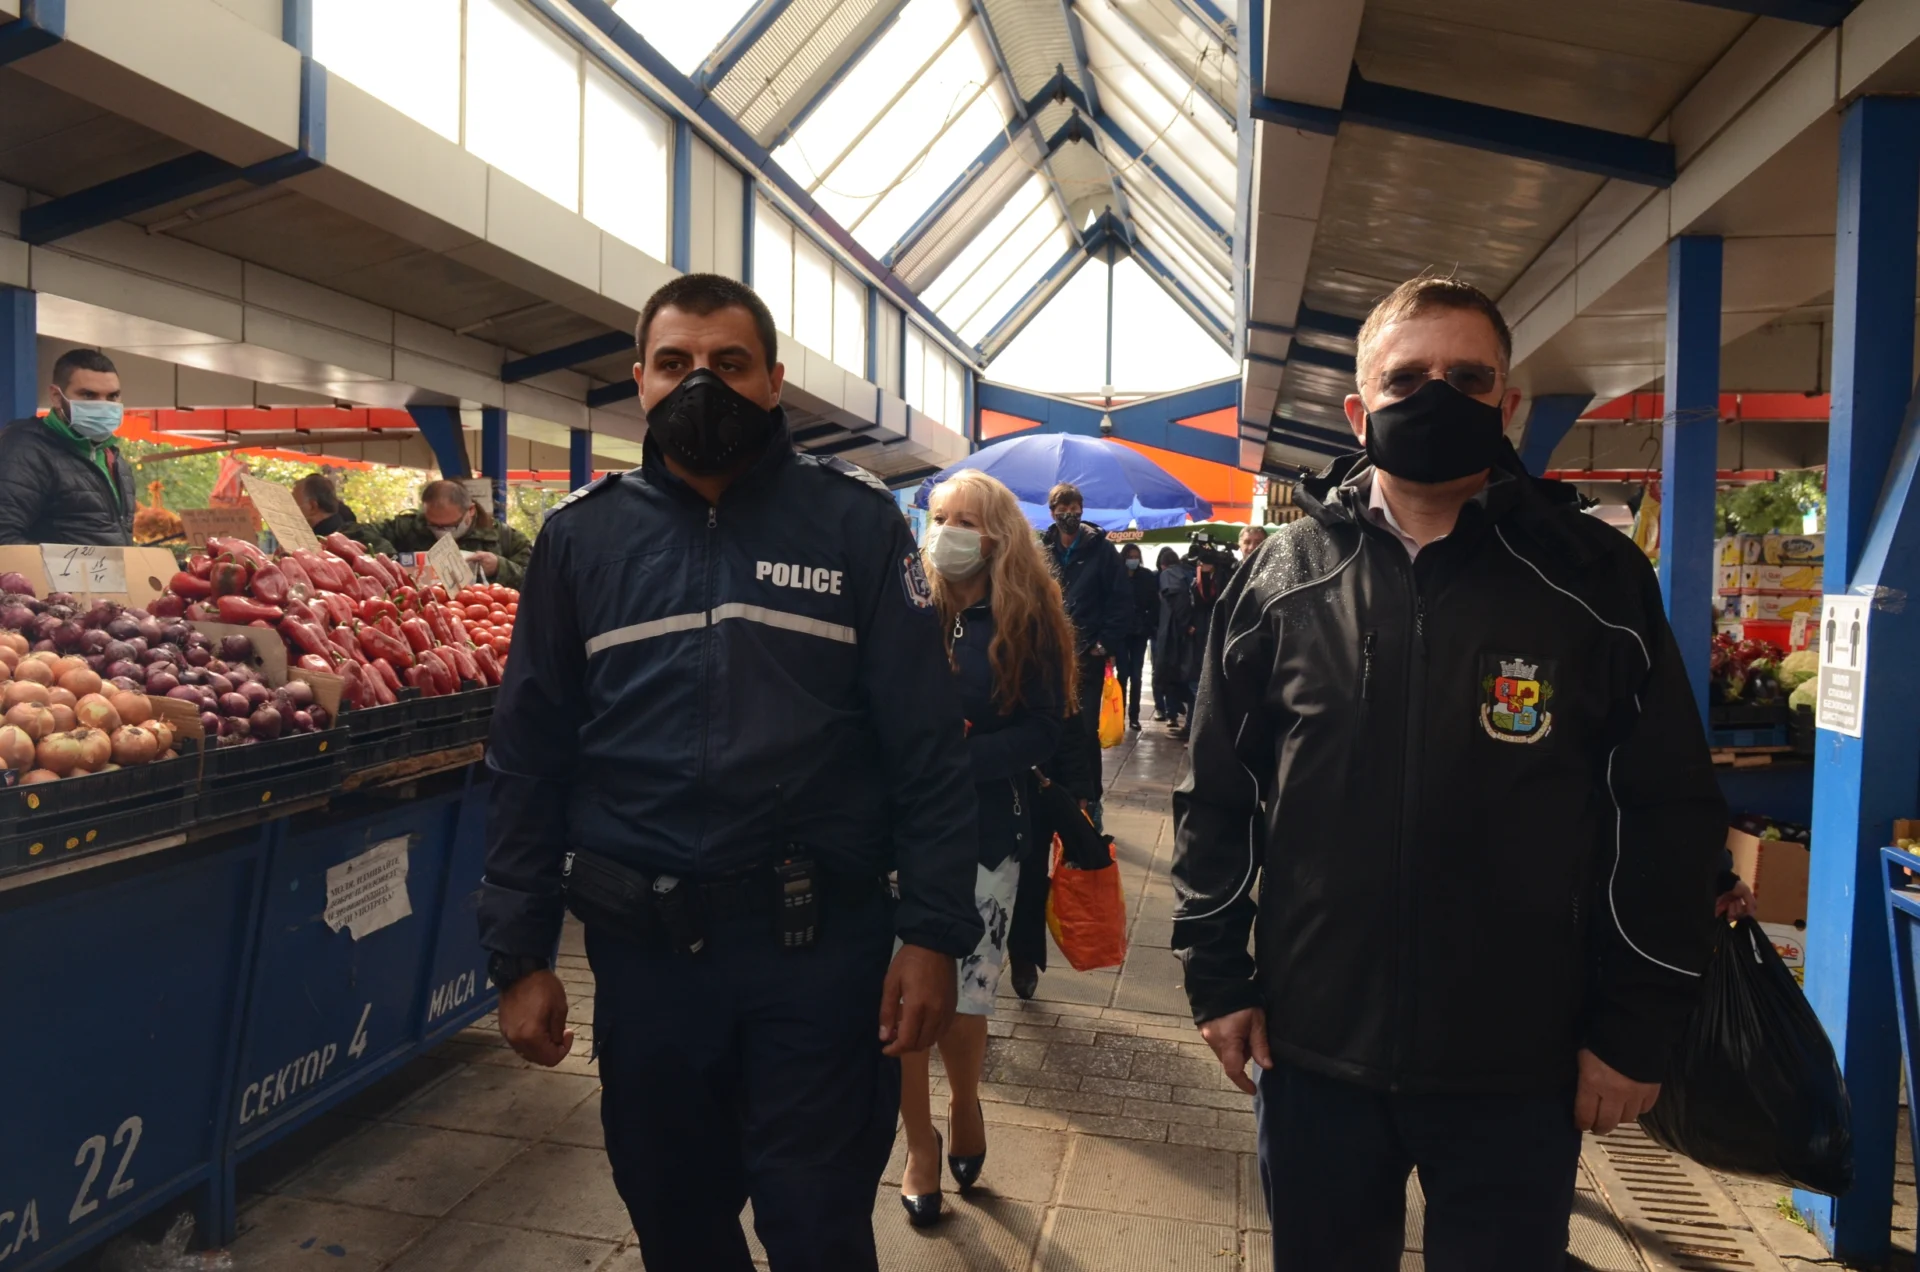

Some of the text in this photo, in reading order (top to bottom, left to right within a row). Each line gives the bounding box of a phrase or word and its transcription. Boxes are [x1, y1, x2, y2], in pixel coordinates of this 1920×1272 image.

[756, 560, 843, 595] POLICE
[1770, 942, 1799, 958] ole
[427, 969, 475, 1022] МАСА
[239, 1002, 372, 1124] СЕКТОР 4
[68, 1115, 143, 1225] 22
